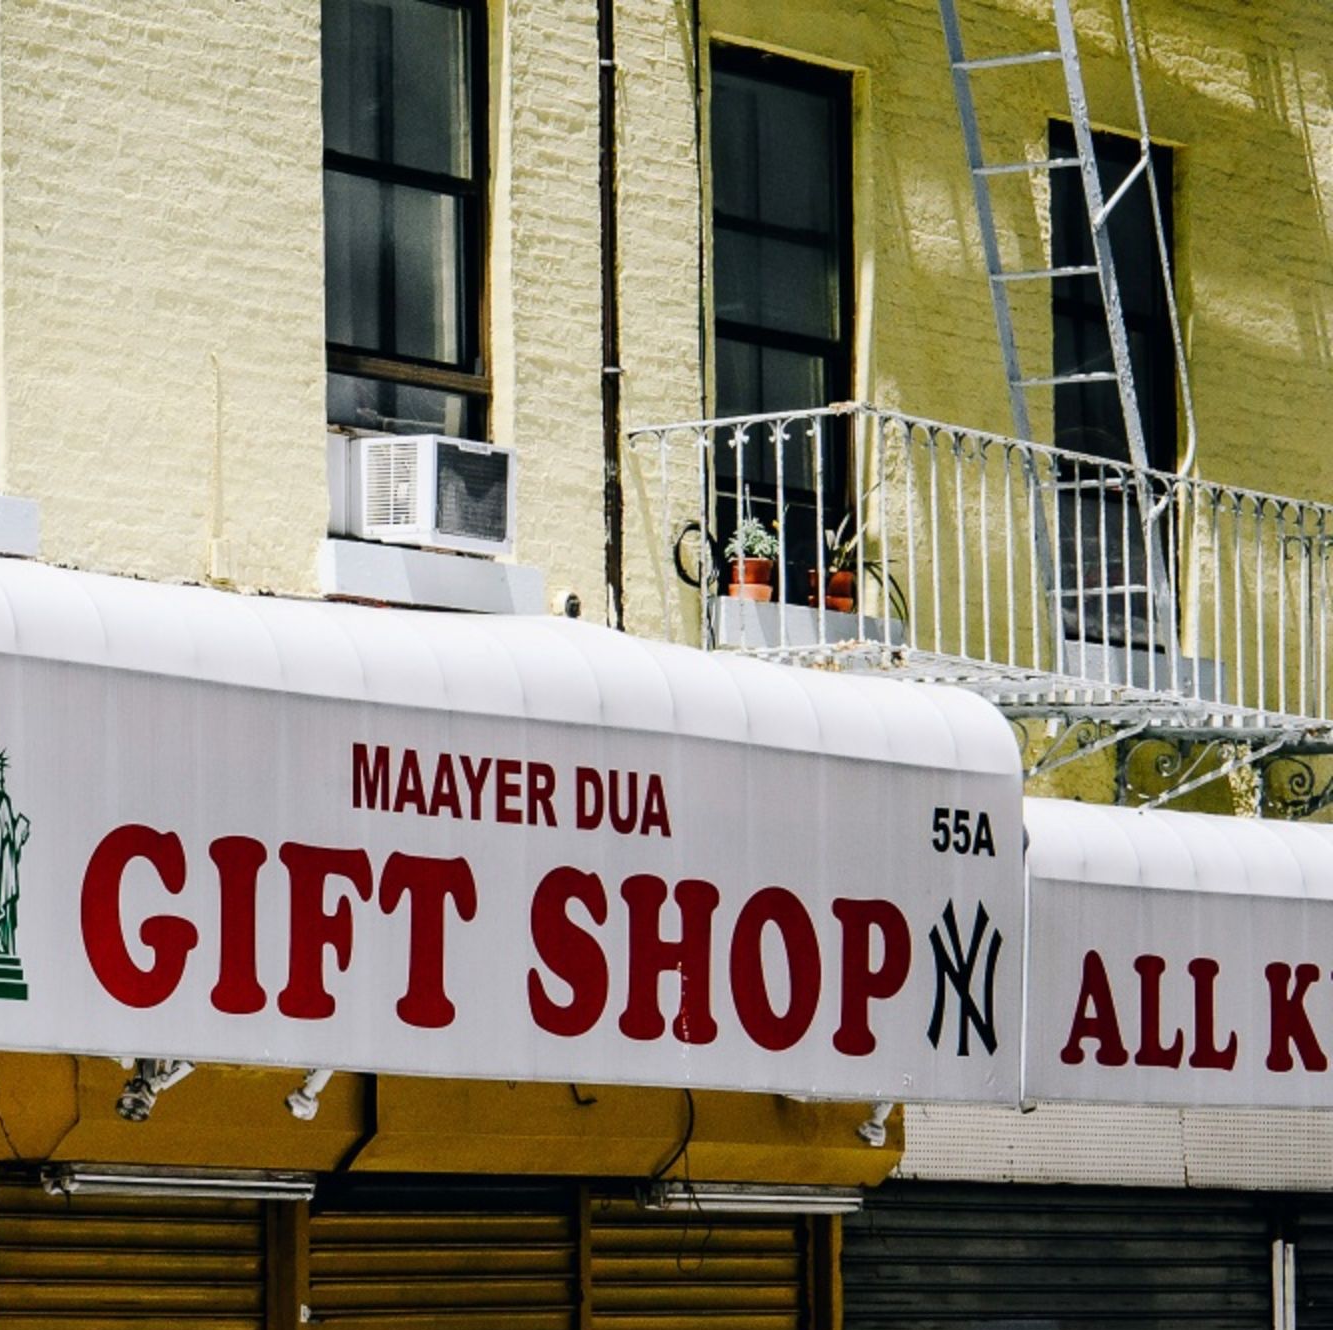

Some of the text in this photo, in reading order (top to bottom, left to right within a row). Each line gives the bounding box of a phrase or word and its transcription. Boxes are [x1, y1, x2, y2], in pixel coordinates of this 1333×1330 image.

[352, 743, 672, 838] MAAYER DUA
[933, 807, 995, 856] 55A
[80, 824, 912, 1056] GIFT SHOP
[1061, 949, 1333, 1072] ALL K
